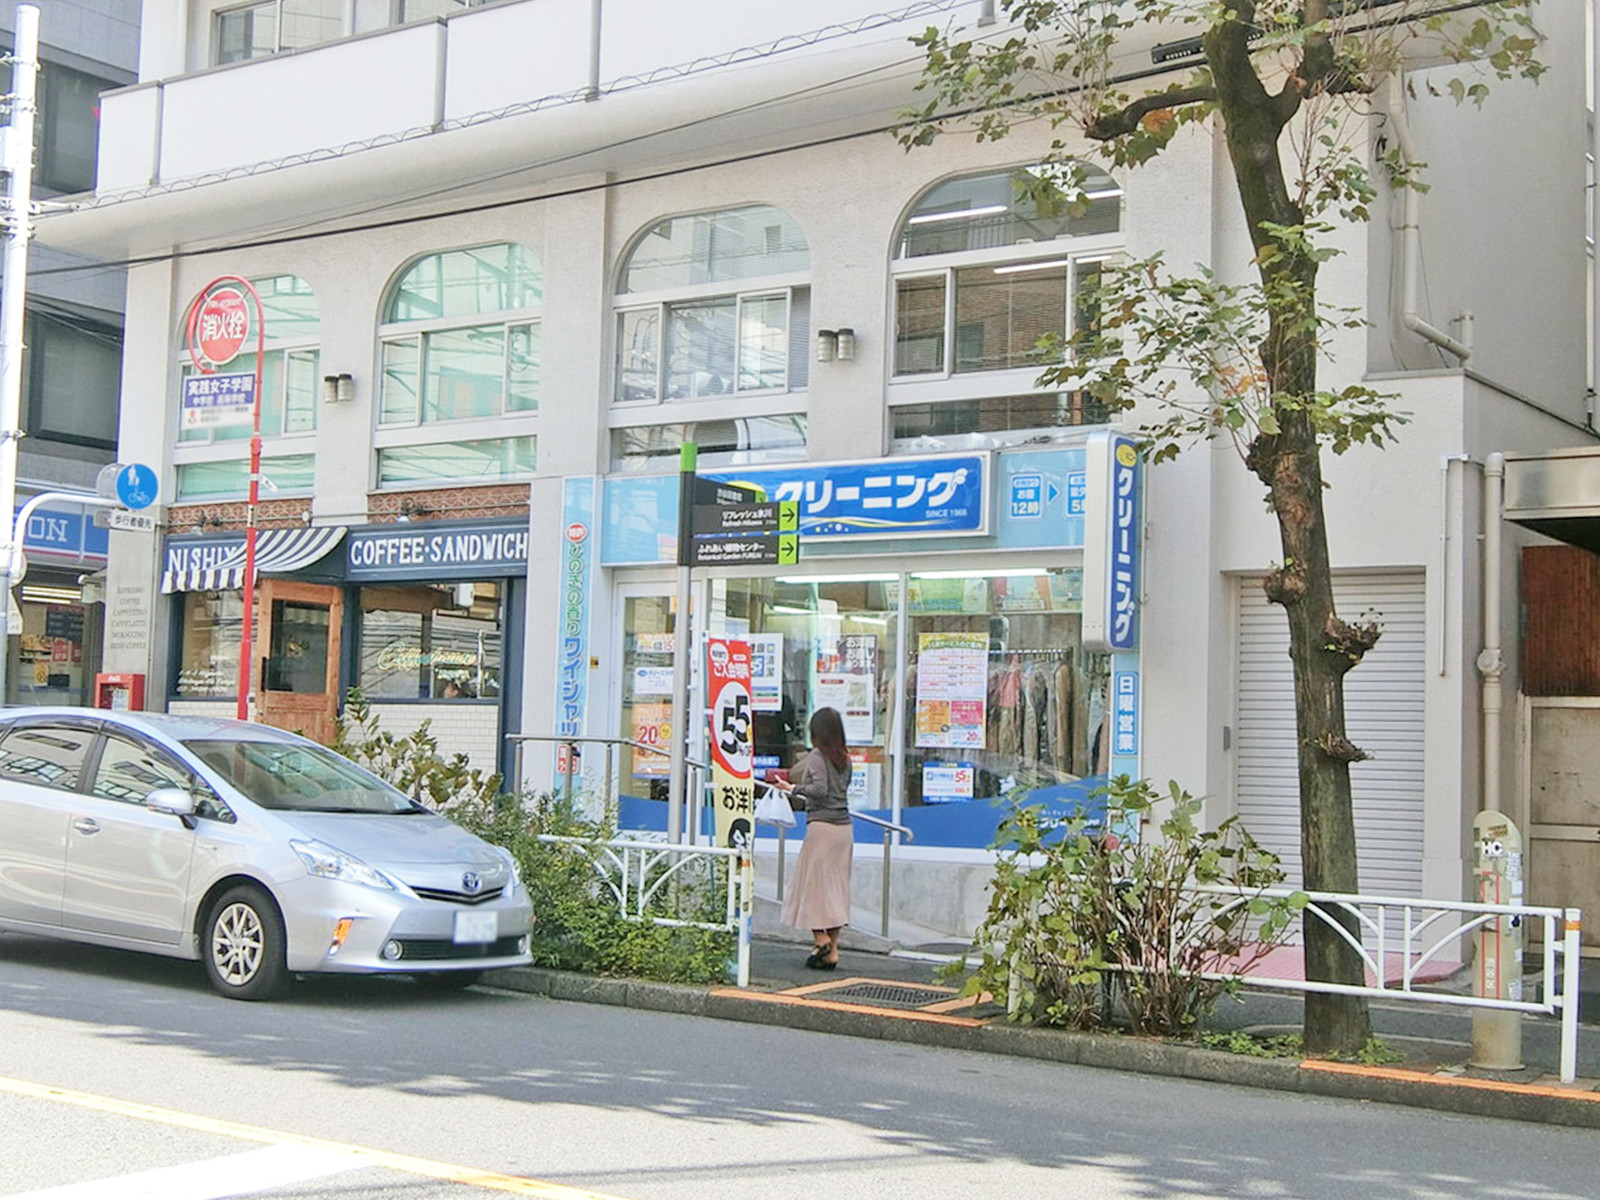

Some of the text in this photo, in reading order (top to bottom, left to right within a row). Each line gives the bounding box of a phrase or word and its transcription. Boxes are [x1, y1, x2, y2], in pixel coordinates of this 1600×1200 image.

[202, 310, 244, 341] 消火栓
[773, 468, 968, 515] クリーニング
[1012, 501, 1039, 515] 12時
[925, 509, 948, 518] SINCE
[1115, 468, 1136, 643] クリーニング
[1118, 676, 1134, 752] 日曜営業
